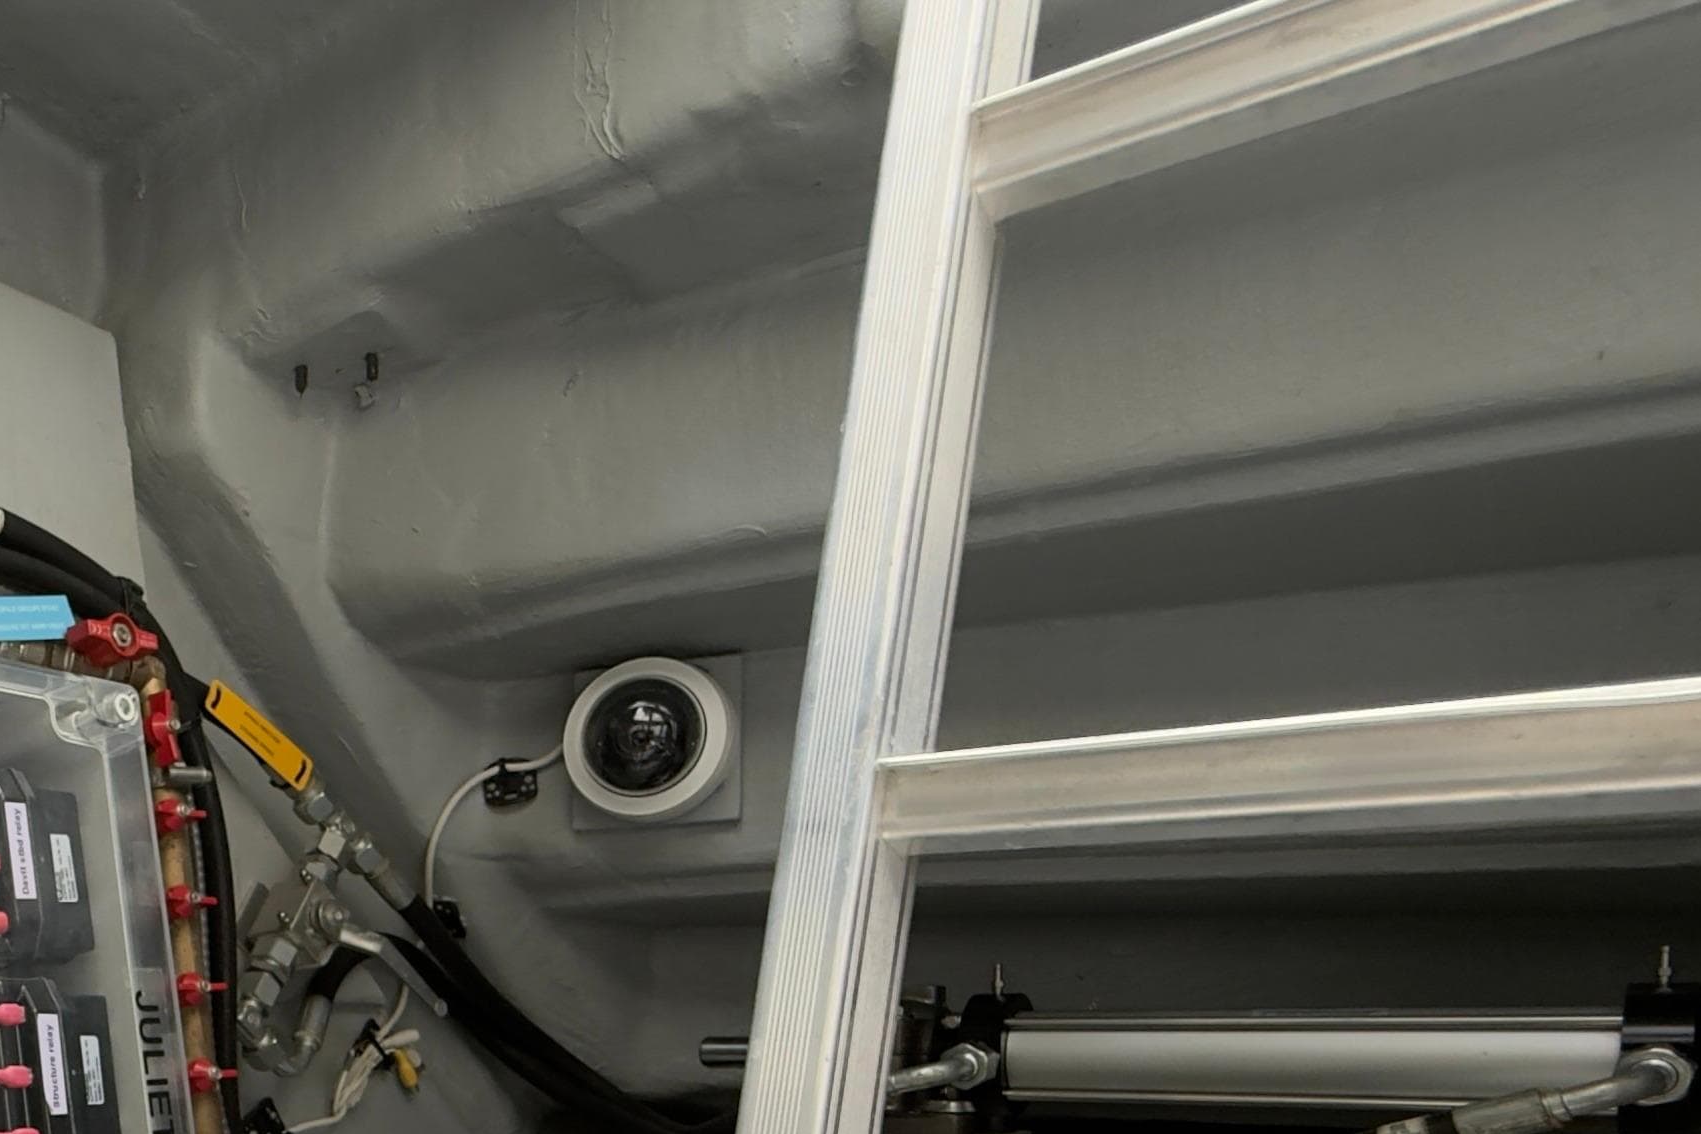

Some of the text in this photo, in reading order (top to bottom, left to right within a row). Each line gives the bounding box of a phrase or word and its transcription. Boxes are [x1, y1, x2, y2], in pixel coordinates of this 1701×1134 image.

[13, 808, 30, 895] Davit stbd relay
[45, 1024, 60, 1108] Structure relay
